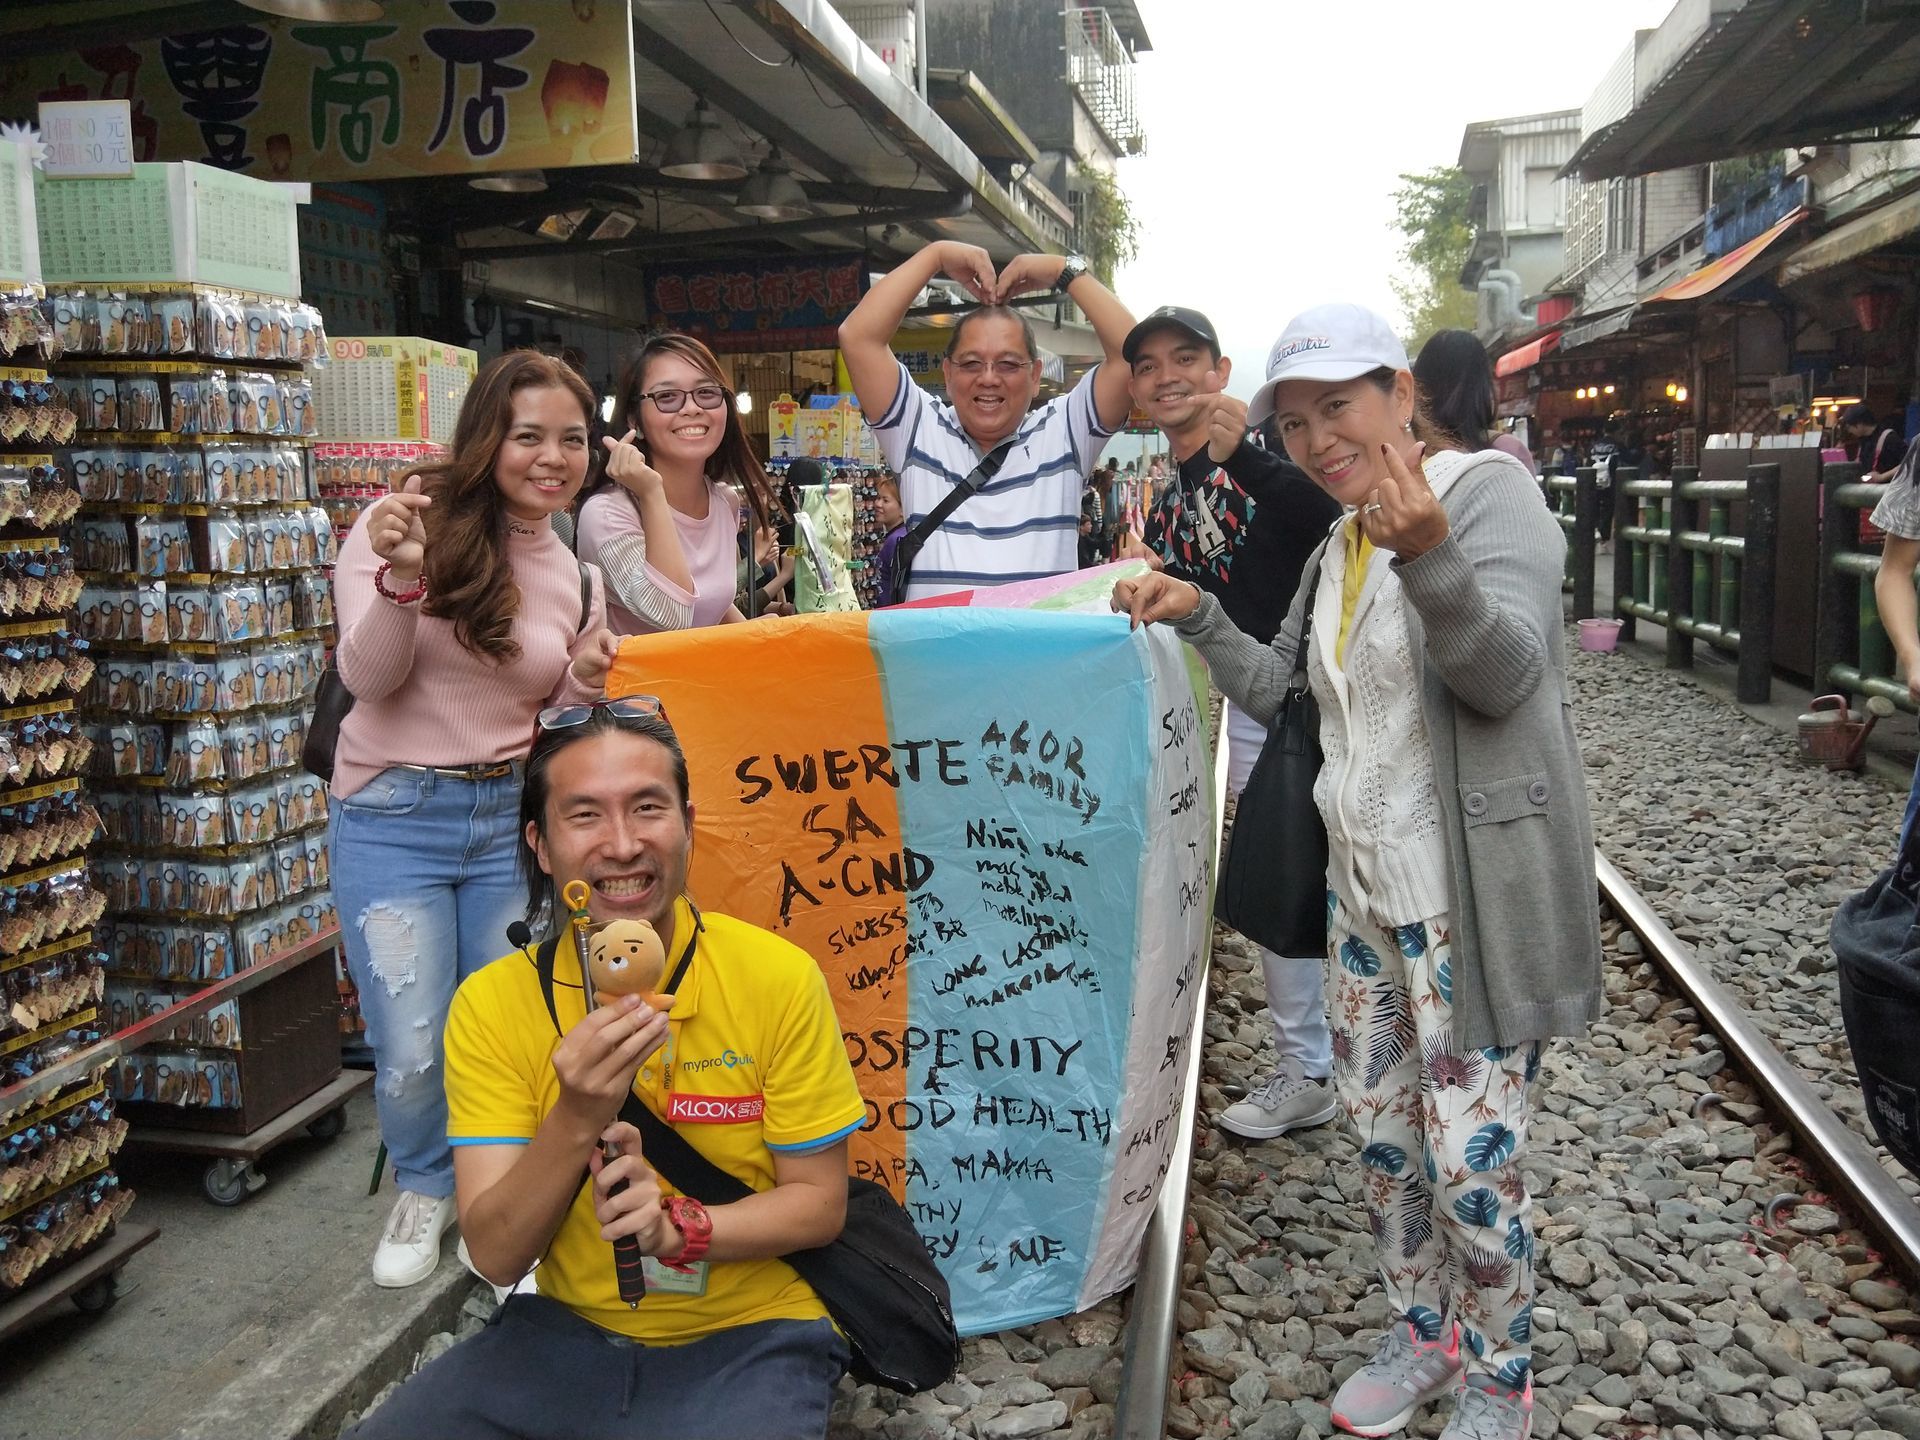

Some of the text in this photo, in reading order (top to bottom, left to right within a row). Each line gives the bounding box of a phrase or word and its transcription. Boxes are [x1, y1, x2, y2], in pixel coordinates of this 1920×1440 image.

[735, 738, 969, 804] SWERTE
[985, 753, 1101, 827] FAMILY
[803, 796, 887, 864] SA
[931, 953, 988, 996] LONG
[842, 1026, 1083, 1076] OSPERITY
[672, 1099, 736, 1119] KLOOK
[858, 1093, 1113, 1147] OOD HEALTH
